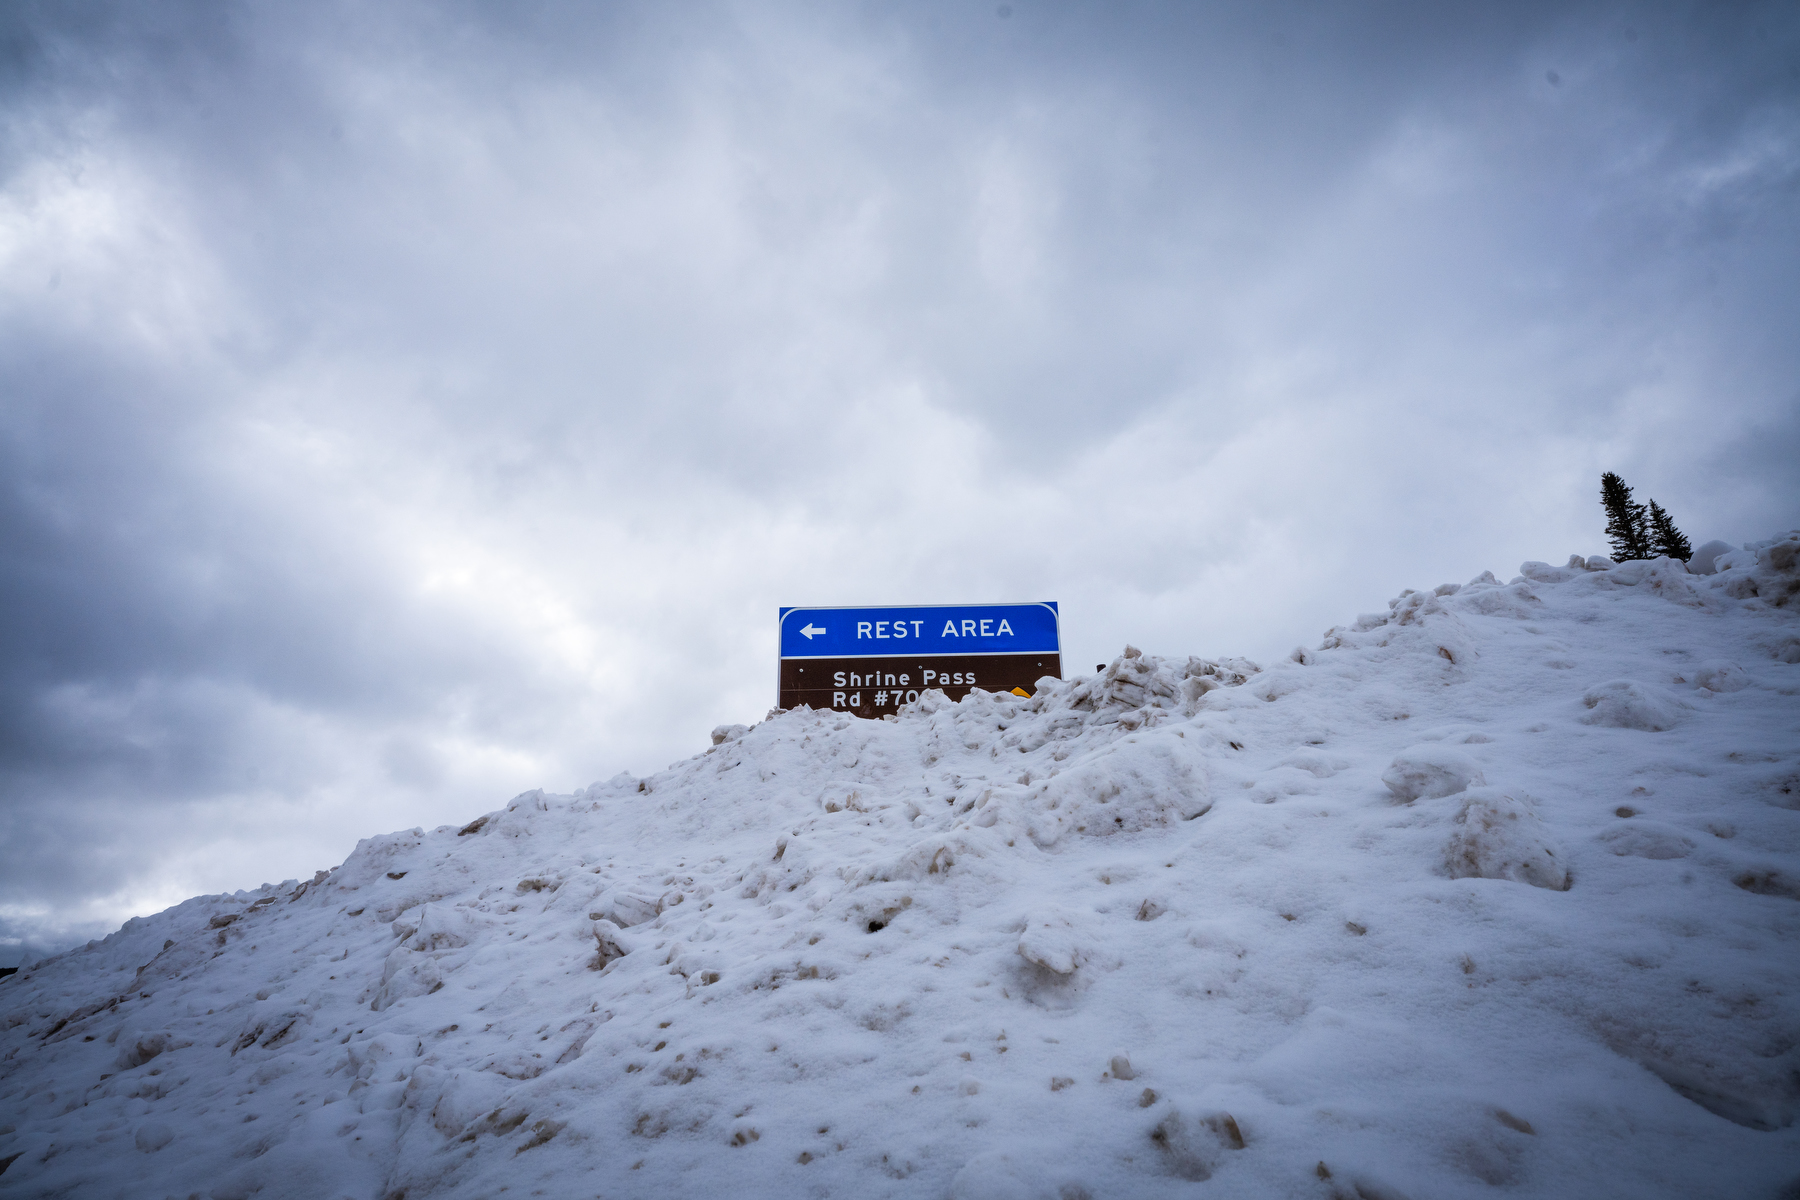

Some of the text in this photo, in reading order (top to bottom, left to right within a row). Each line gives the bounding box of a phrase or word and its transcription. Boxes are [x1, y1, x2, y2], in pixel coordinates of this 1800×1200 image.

[857, 618, 1014, 639] REST AREA
[833, 669, 976, 687] Shrine Pass
[833, 691, 861, 707] Rd
